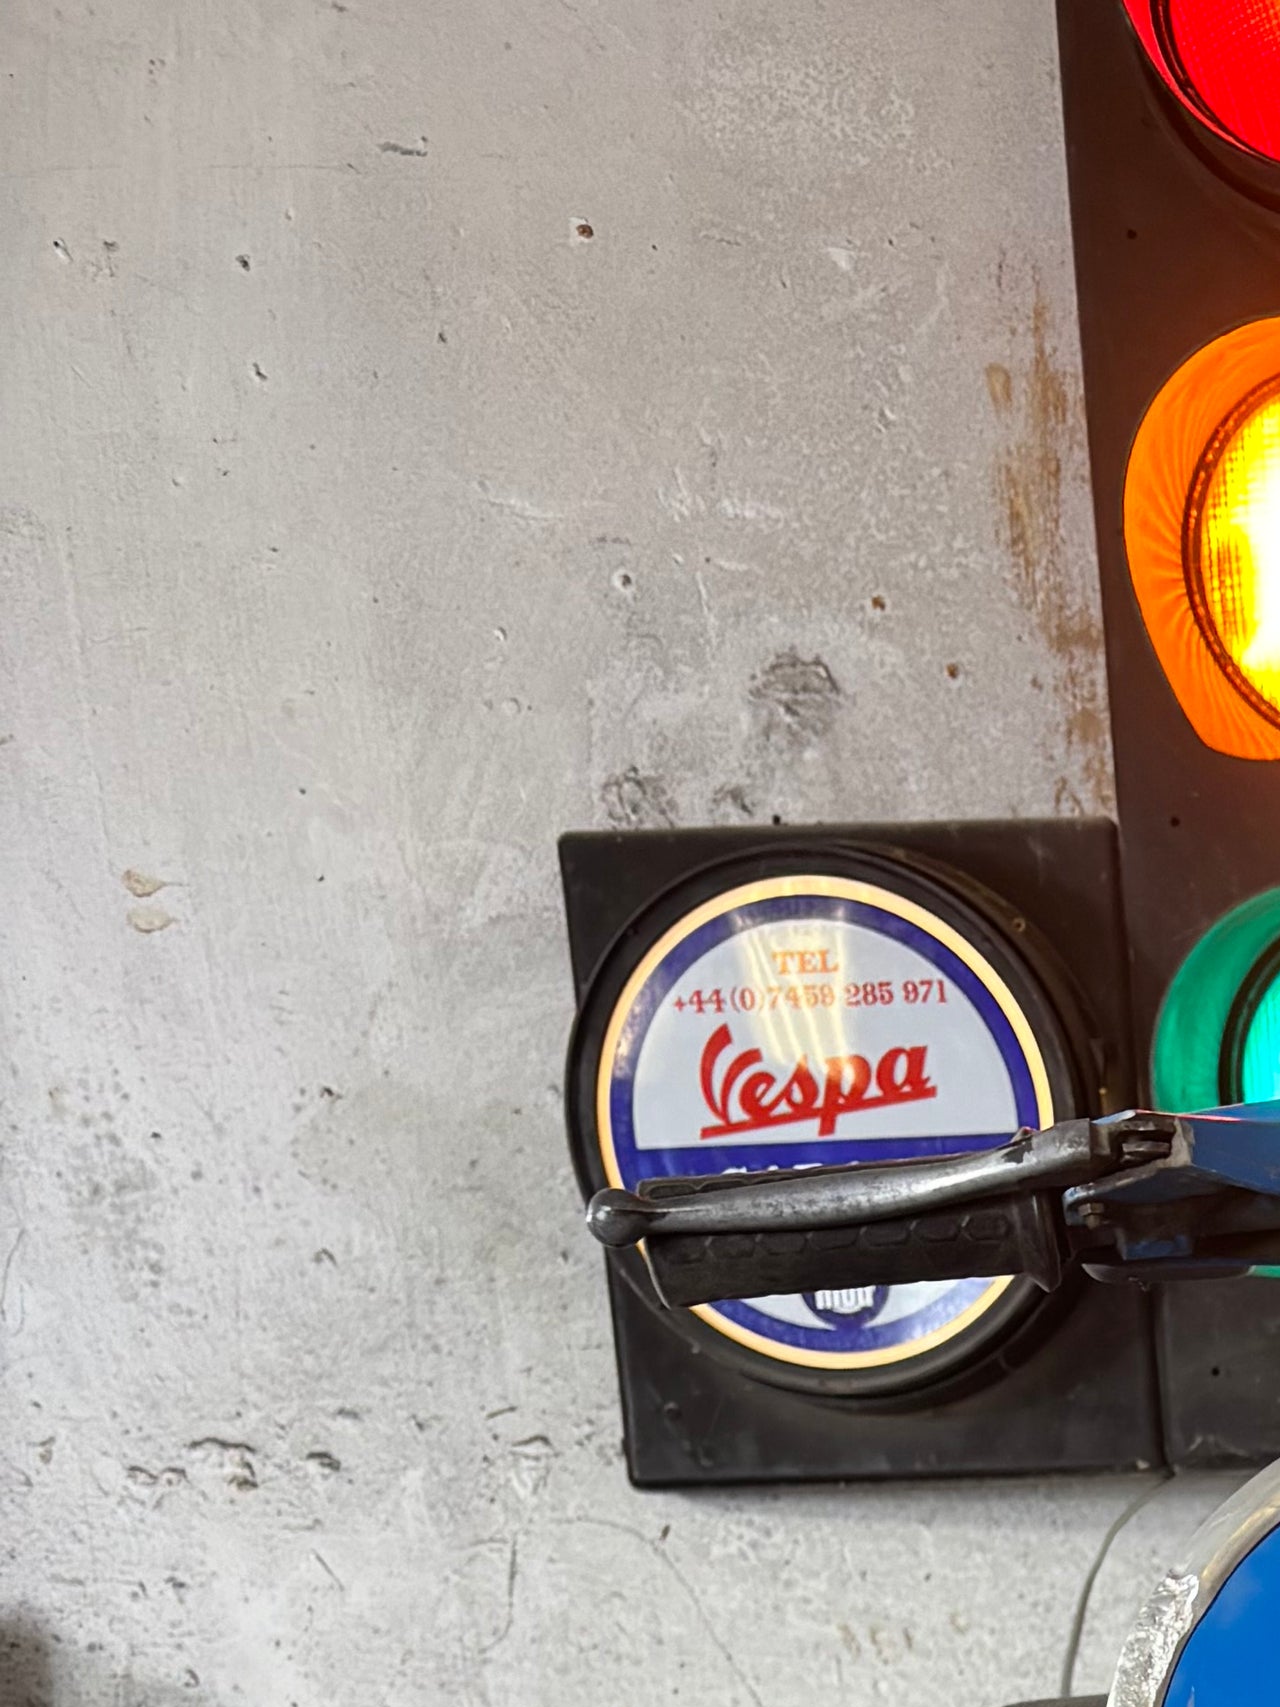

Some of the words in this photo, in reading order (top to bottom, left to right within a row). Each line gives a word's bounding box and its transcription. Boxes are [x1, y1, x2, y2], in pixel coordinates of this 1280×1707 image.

[771, 948, 840, 976] TEL
[844, 980, 895, 1007] 285
[902, 978, 948, 1005] 971
[699, 1022, 938, 1141] Vespa
